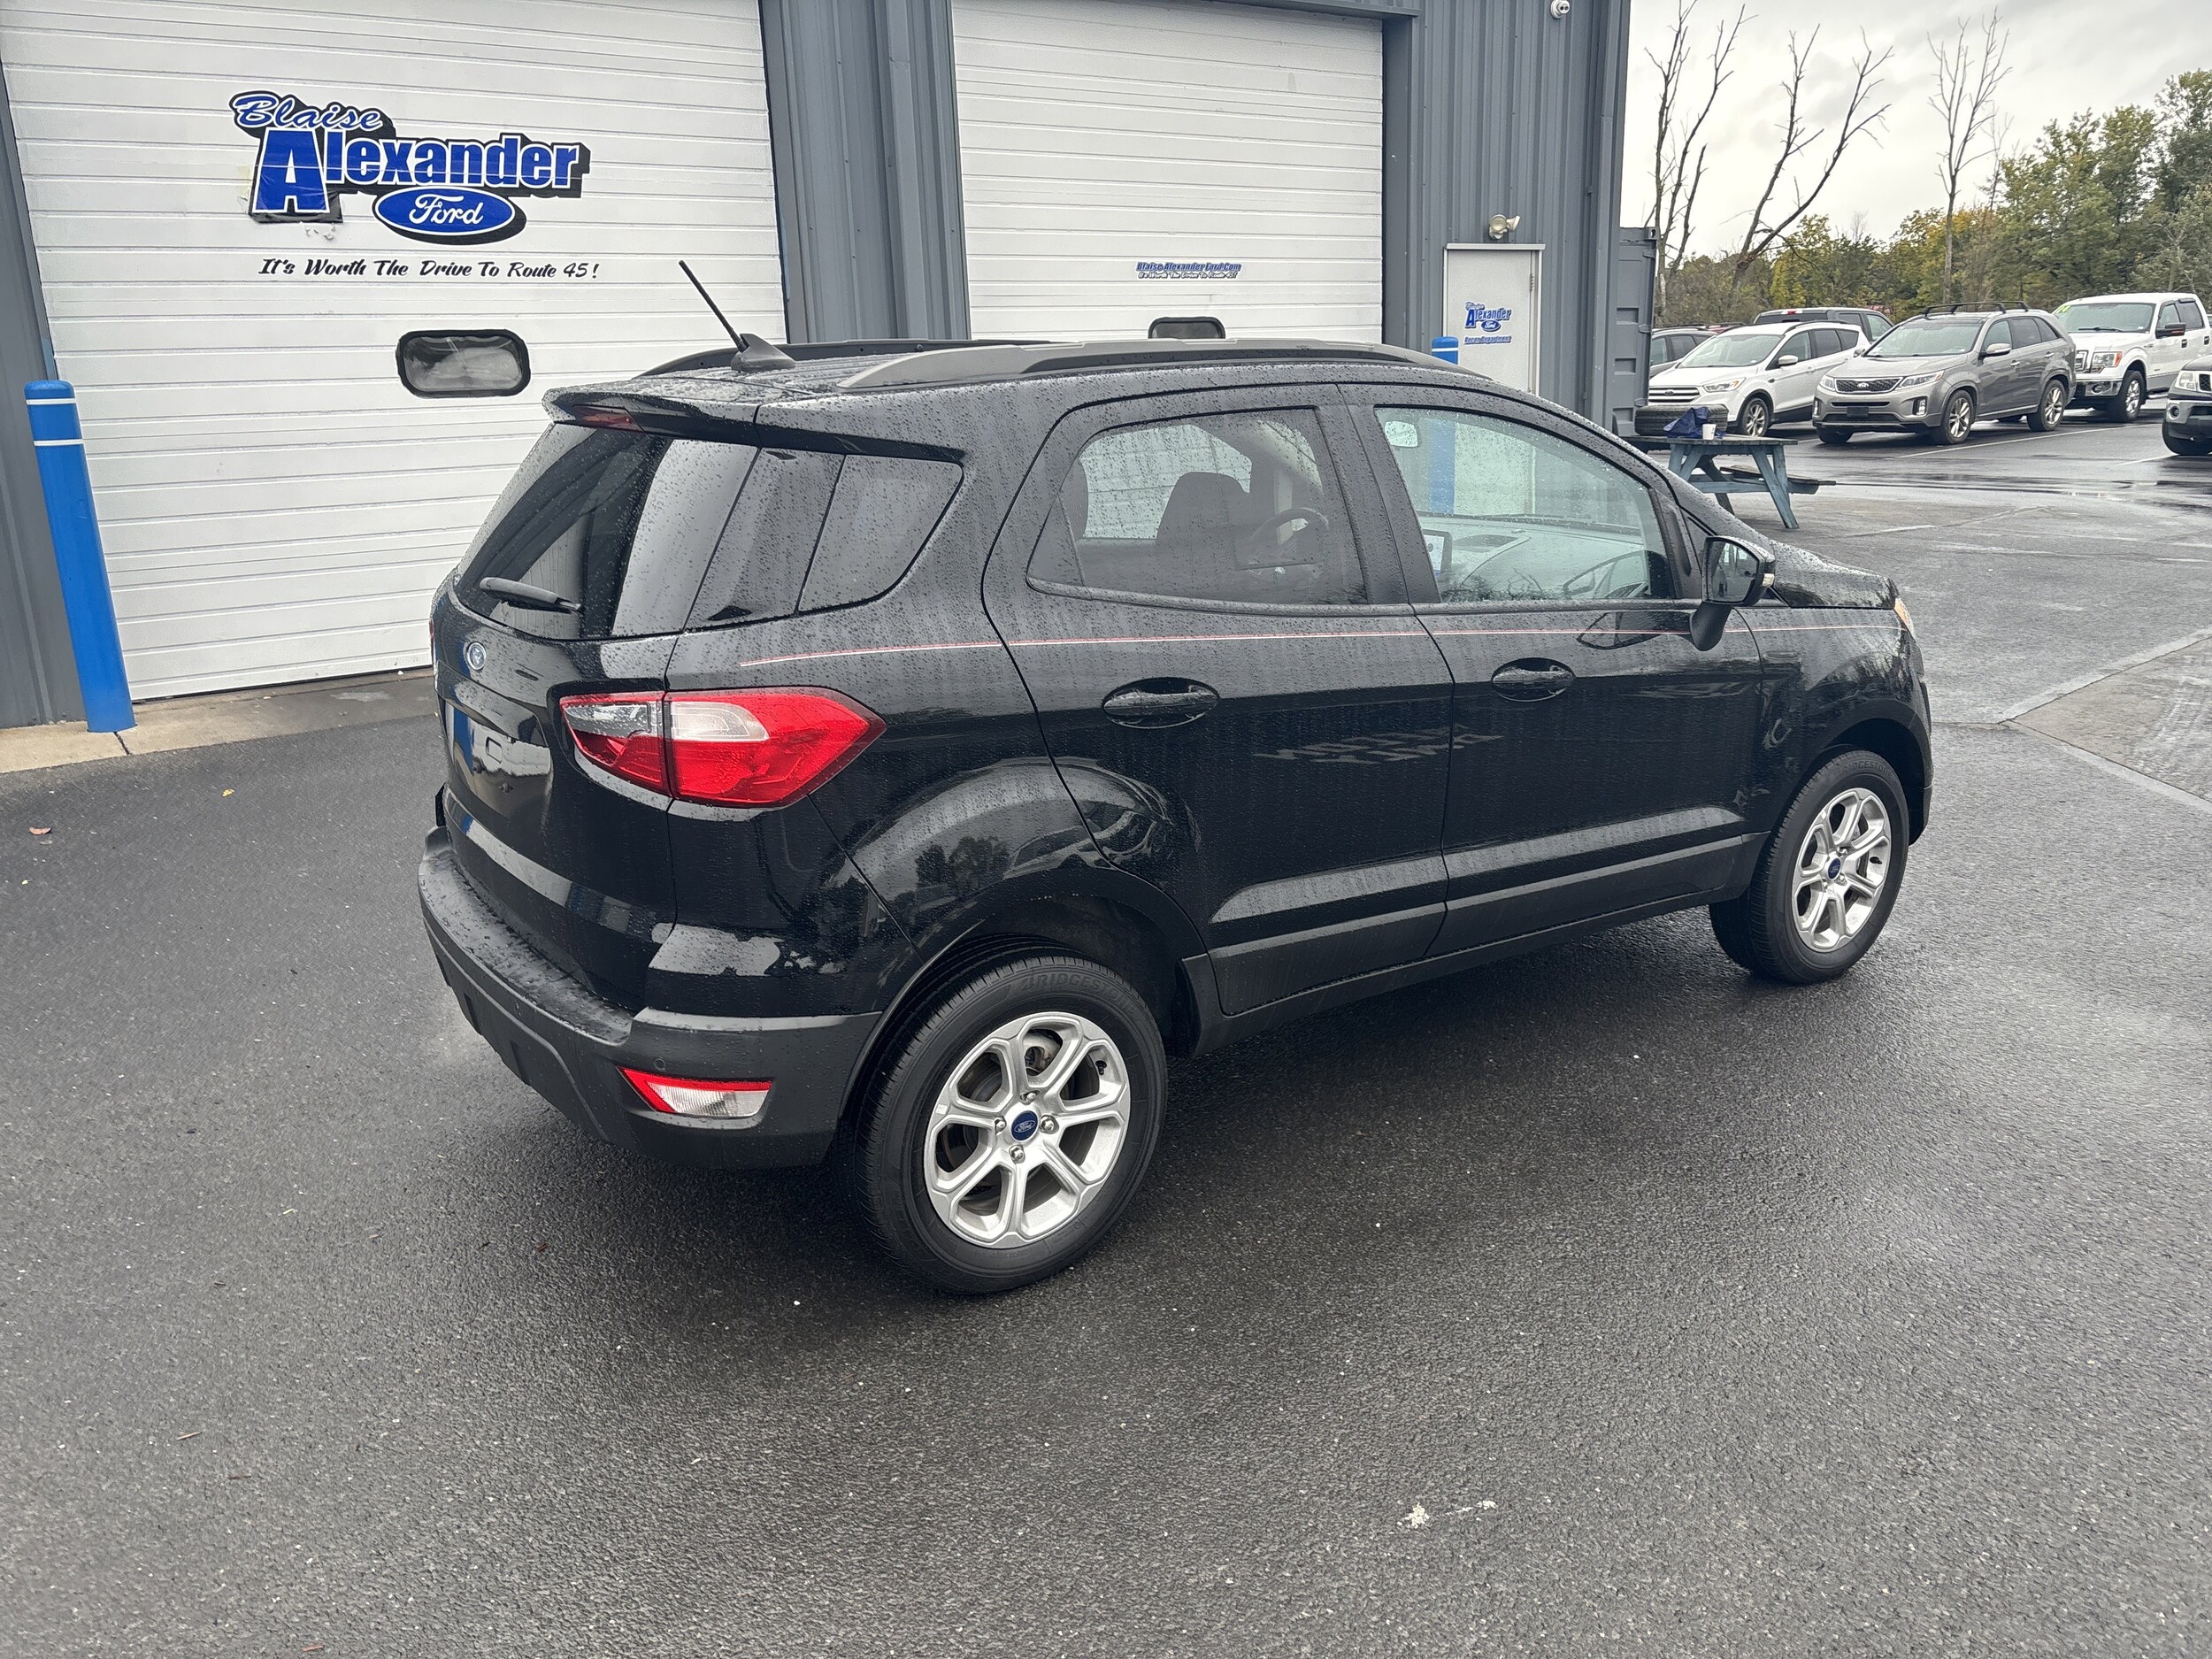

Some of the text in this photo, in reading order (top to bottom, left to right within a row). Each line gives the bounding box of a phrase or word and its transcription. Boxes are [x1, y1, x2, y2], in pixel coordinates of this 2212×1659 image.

[233, 94, 383, 132] Blaise
[252, 127, 582, 213] Alexander
[408, 194, 484, 225] Ford
[258, 257, 296, 275] It's
[304, 258, 367, 276] Worth
[373, 259, 409, 276] The
[419, 260, 472, 277] Drive
[478, 261, 500, 278] To
[507, 262, 557, 278] Route
[1136, 262, 1164, 272] Blaise
[1164, 262, 1205, 272] Alexander
[1464, 307, 1511, 328] Alexander
